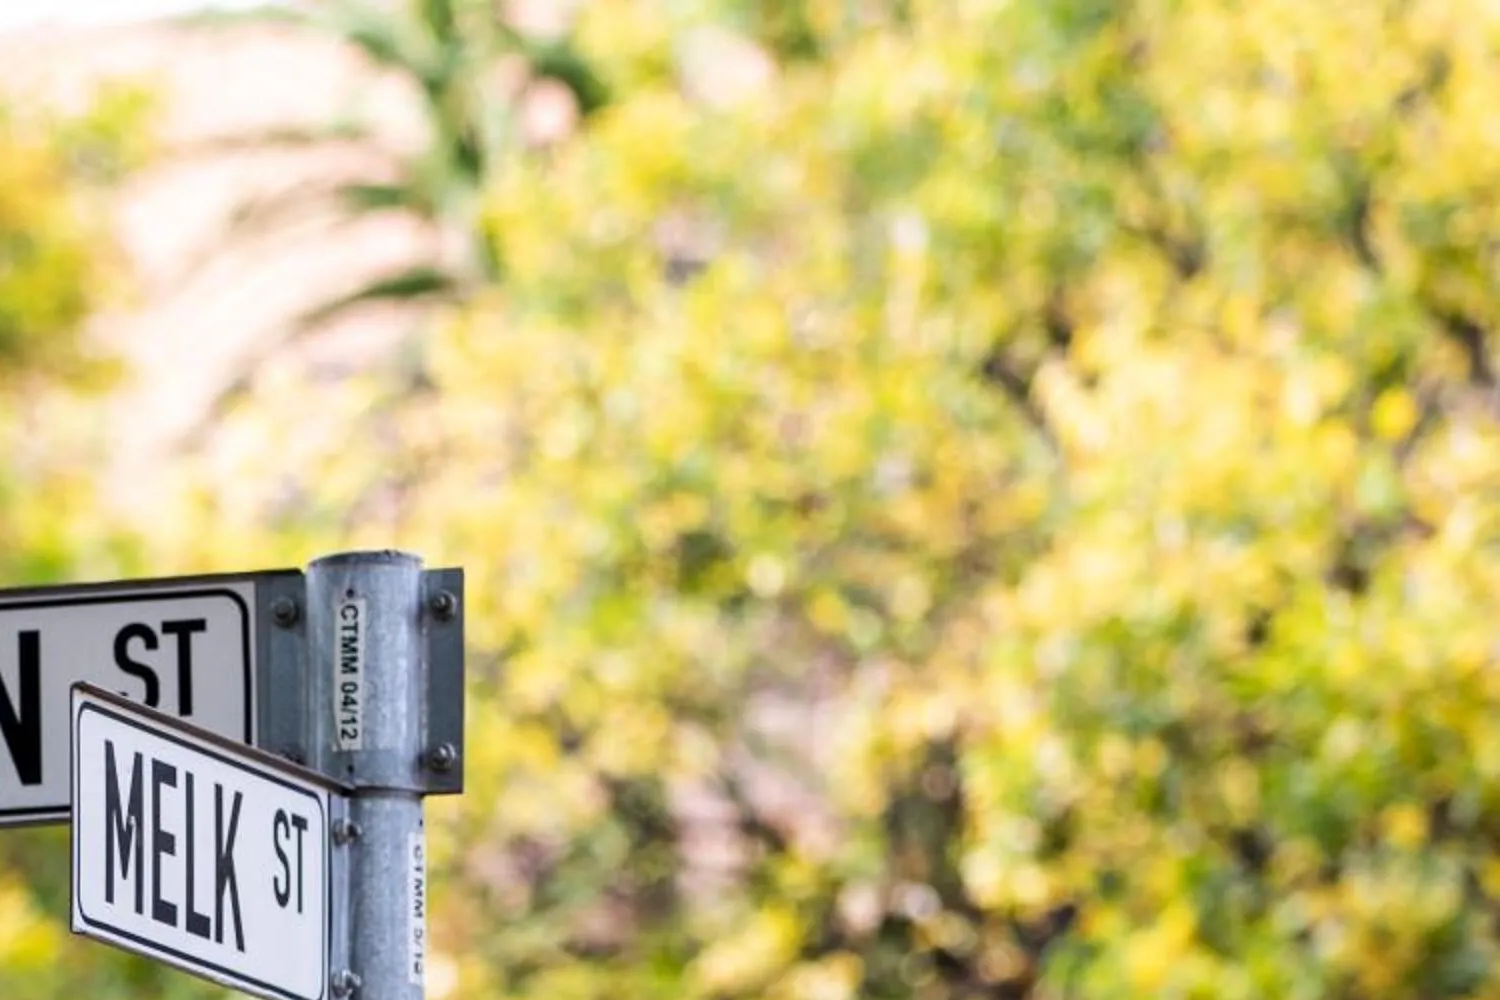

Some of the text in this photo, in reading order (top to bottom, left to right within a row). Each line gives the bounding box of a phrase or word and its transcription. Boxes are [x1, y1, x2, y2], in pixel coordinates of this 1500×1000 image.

[113, 618, 207, 717] ST
[340, 604, 359, 741] CTMM 04/12
[104, 739, 309, 954] MELK ST
